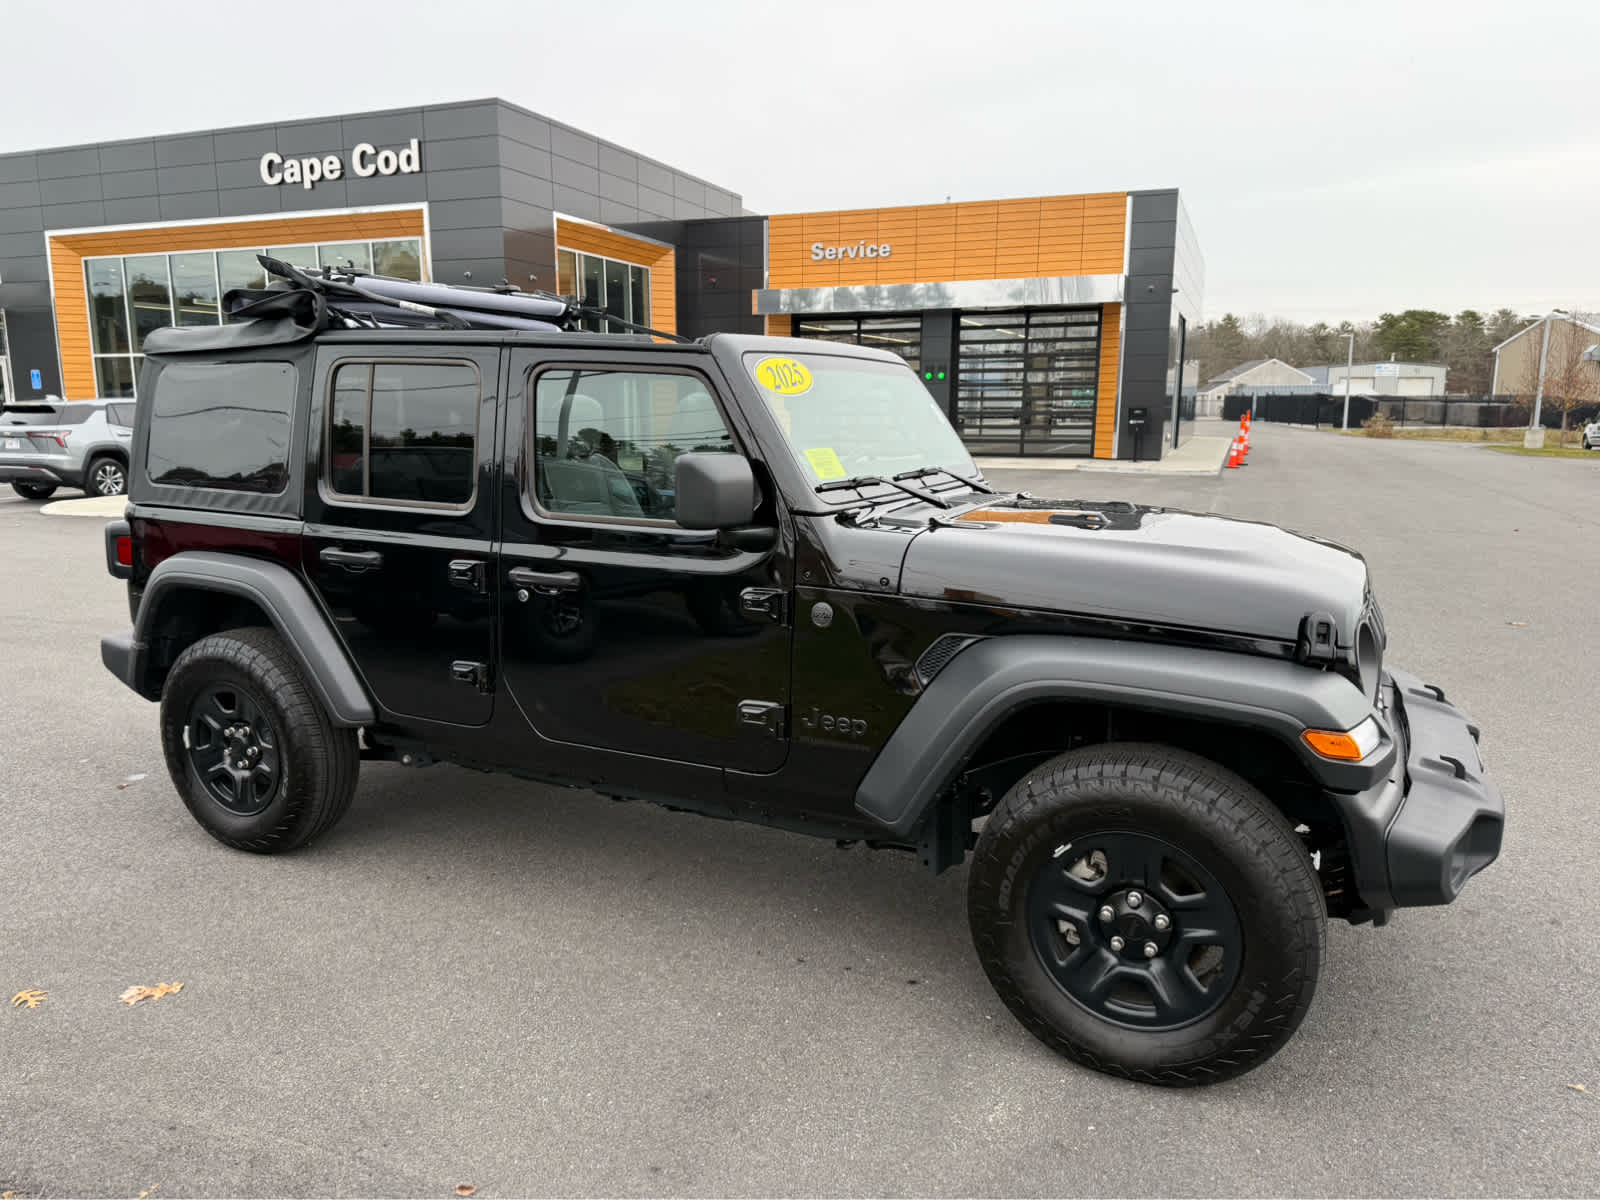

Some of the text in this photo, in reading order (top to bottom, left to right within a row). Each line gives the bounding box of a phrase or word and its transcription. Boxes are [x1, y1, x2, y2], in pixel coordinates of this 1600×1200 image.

[259, 138, 421, 189] Cape Cod
[810, 241, 892, 261] Service
[766, 362, 805, 390] 2025
[801, 706, 868, 739] Jeep
